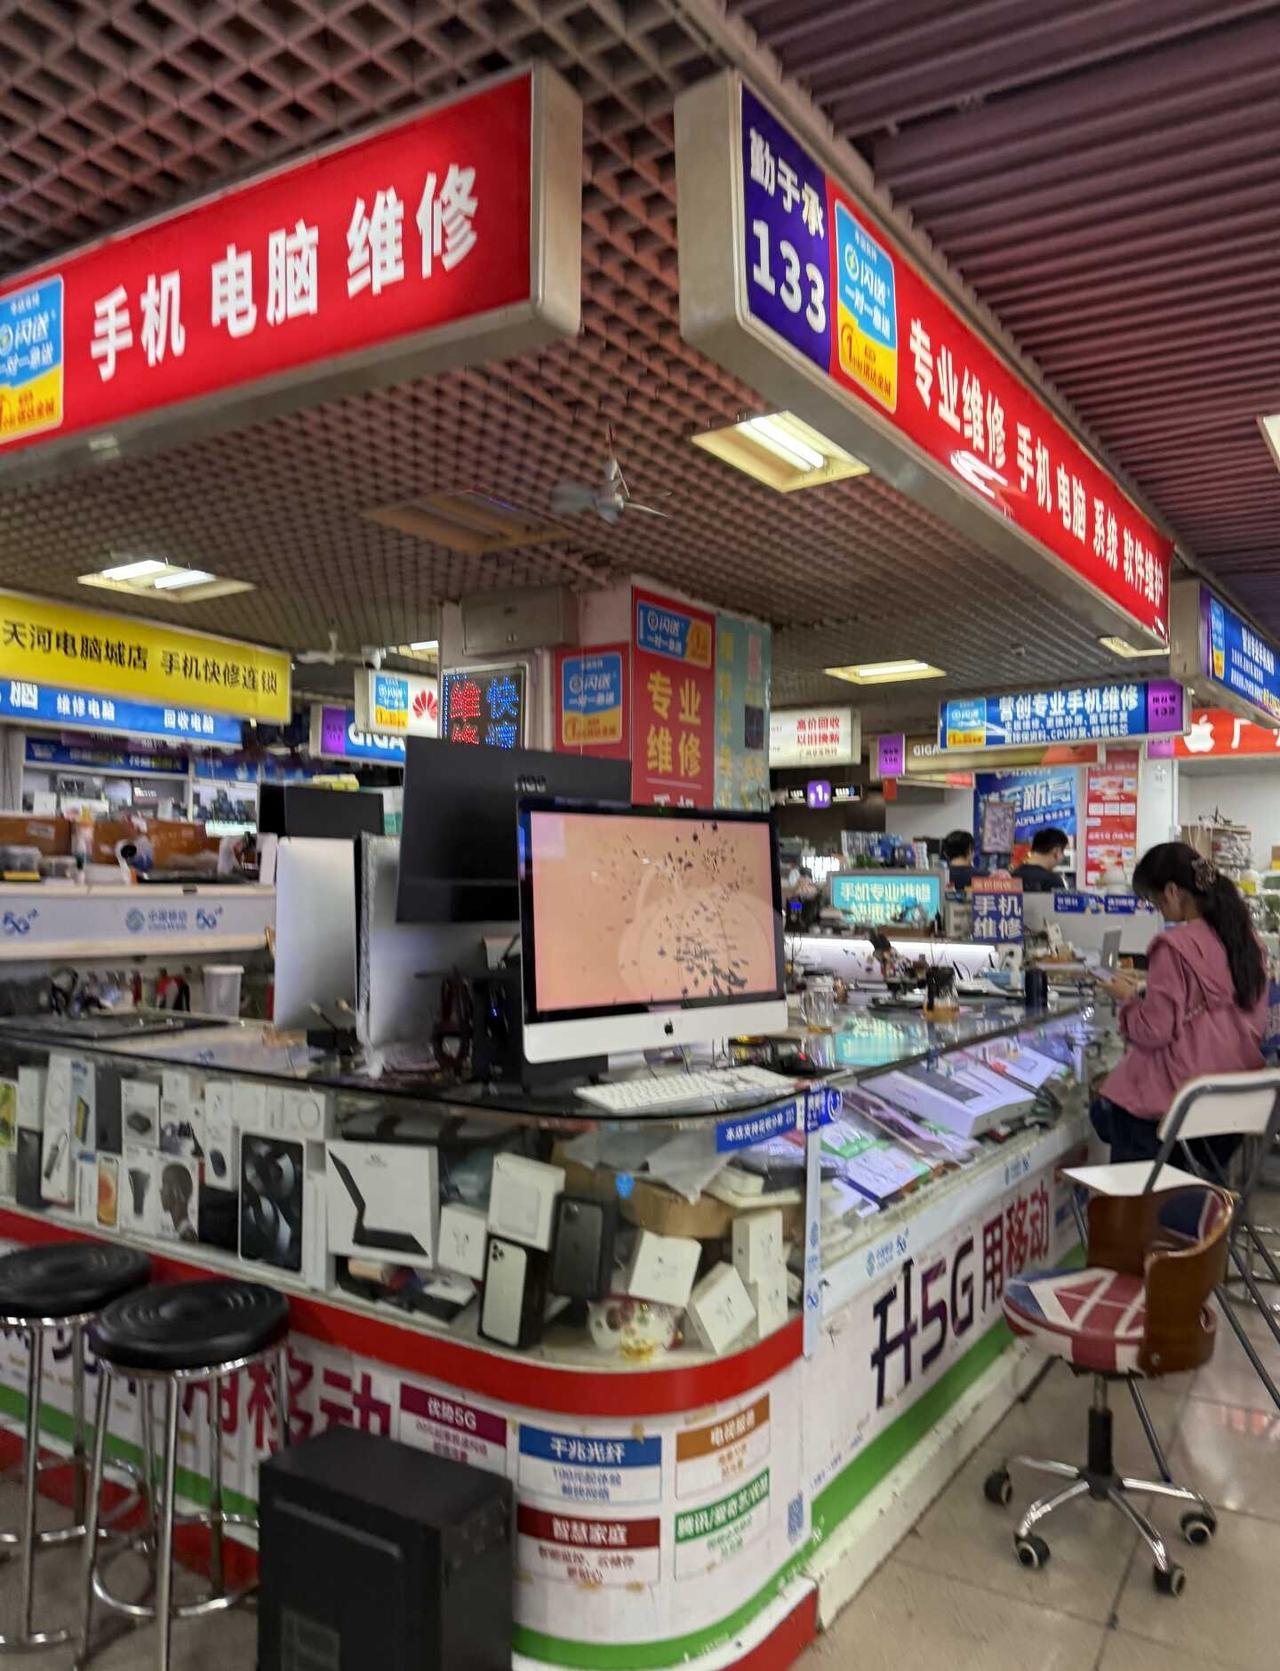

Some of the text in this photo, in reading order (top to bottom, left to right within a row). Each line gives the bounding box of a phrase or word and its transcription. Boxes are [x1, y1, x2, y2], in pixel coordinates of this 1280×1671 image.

[90, 163, 479, 382] 手机 电脑 维修
[752, 218, 826, 334] 133
[909, 318, 1006, 469] 专业维修
[1016, 422, 1052, 513] 手机
[1056, 462, 1087, 544] 电脑
[1093, 497, 1118, 571] 系统
[1123, 527, 1164, 608] 软件维护
[3, 619, 278, 697] 天河电脑城店 手机快修连锁
[647, 669, 701, 725] 专业
[646, 724, 701, 777] 维修
[973, 895, 1022, 916] 手机
[973, 918, 1022, 939] 维修
